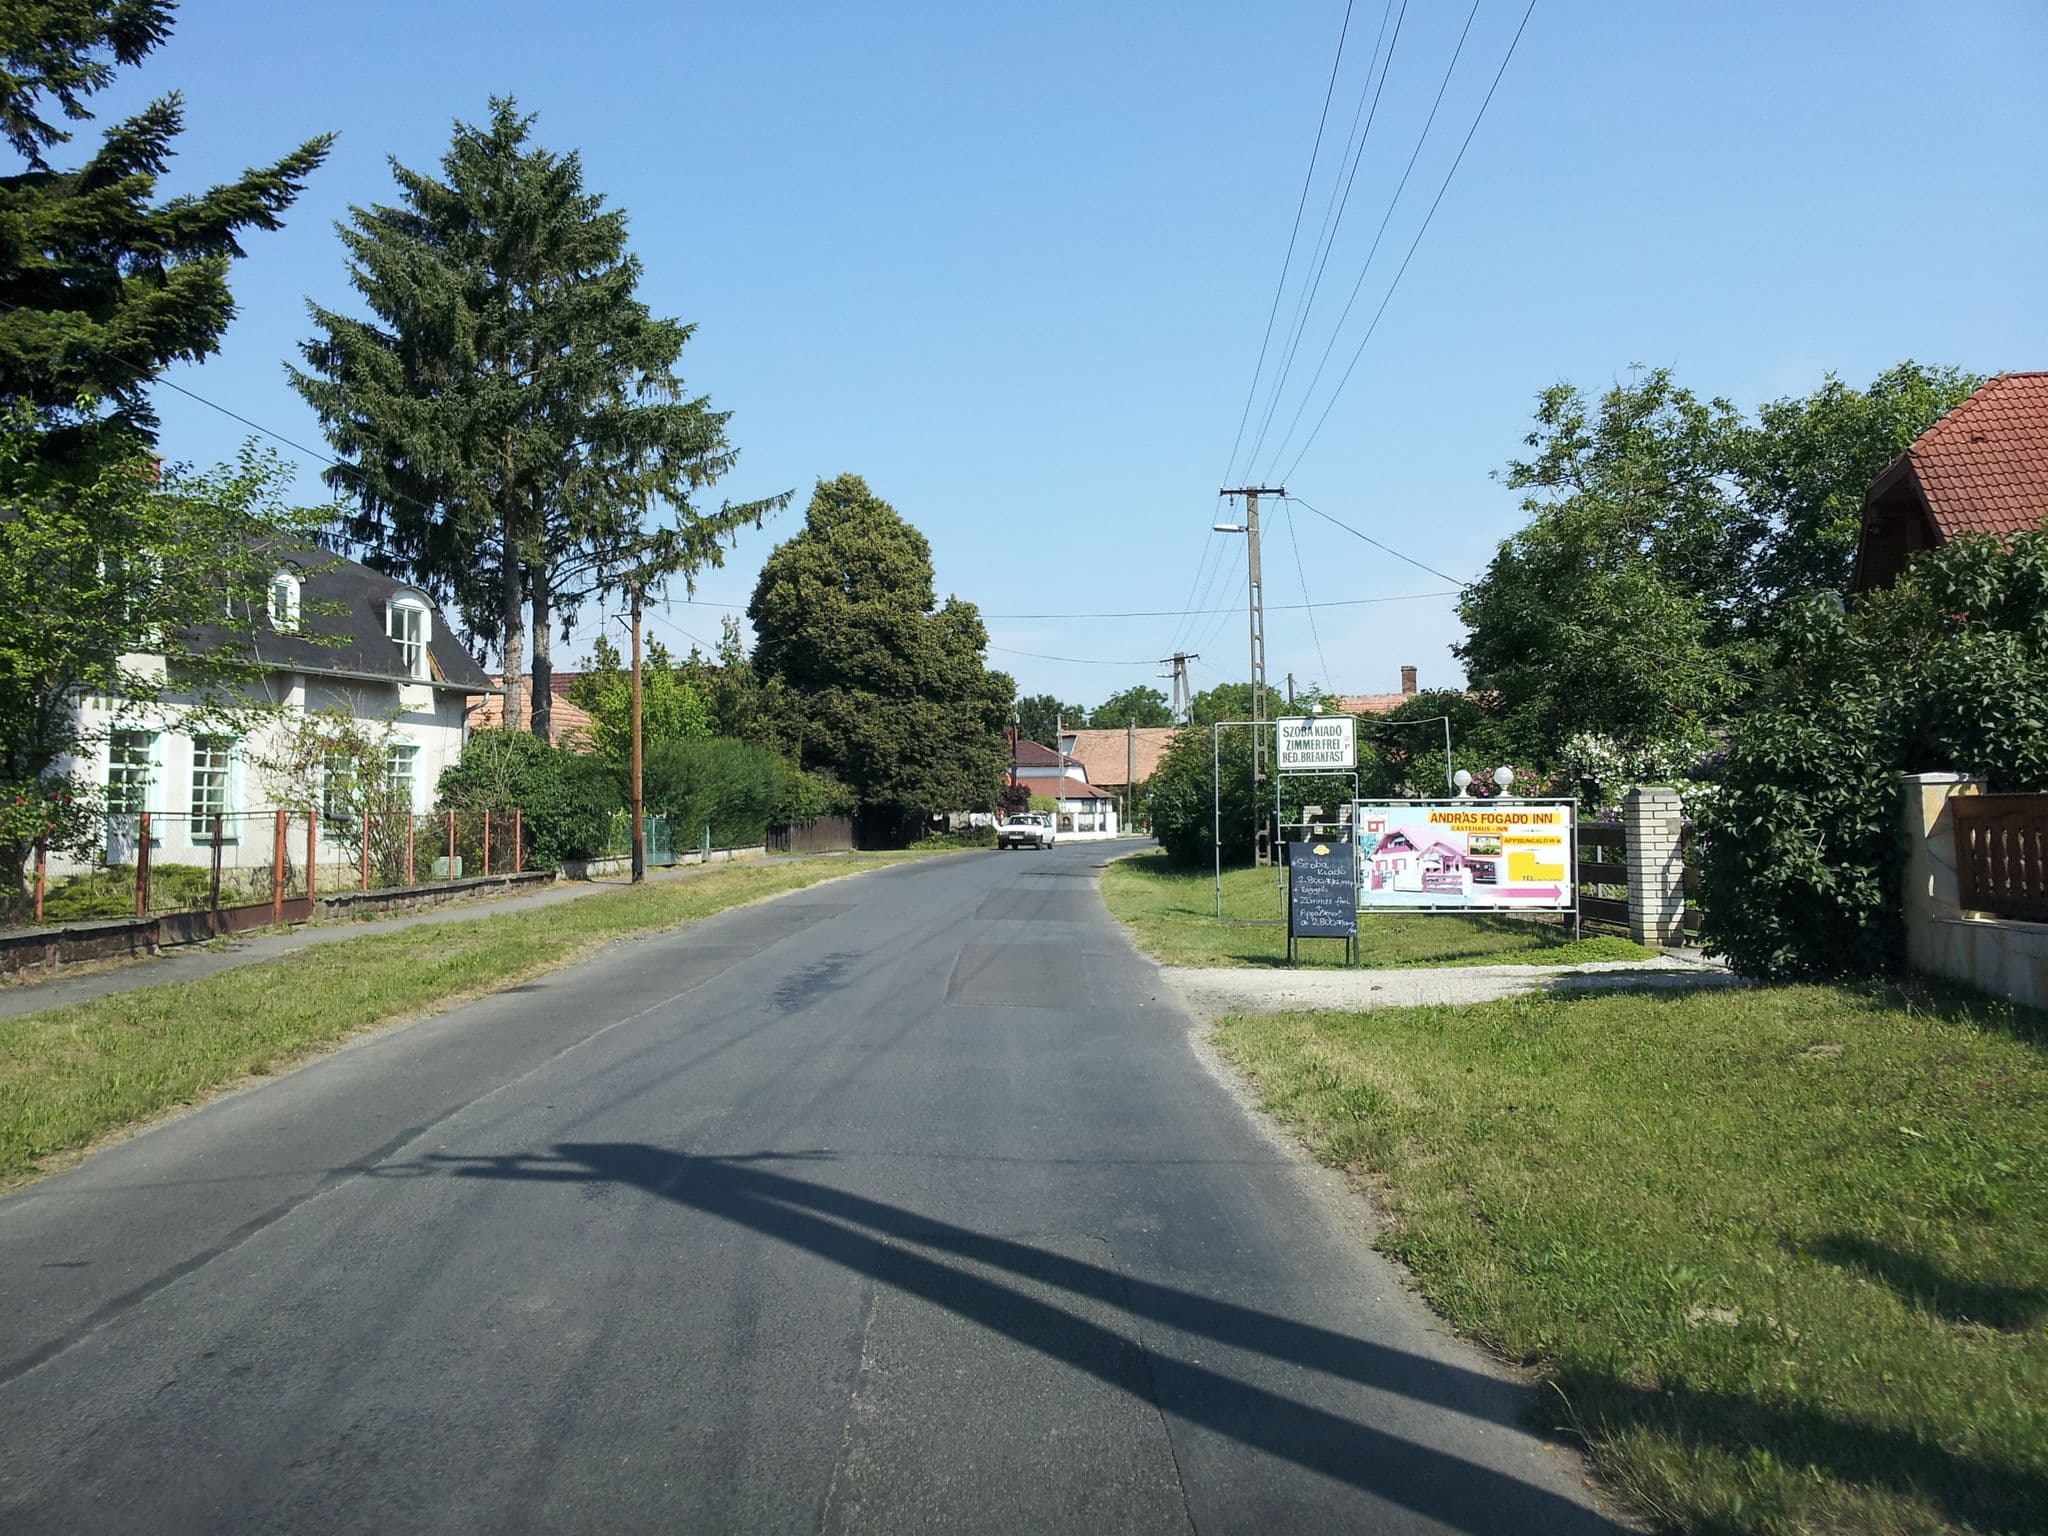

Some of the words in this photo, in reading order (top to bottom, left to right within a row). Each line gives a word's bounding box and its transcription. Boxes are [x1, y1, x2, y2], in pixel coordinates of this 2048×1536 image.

[1283, 726, 1314, 738] SZOBA
[1286, 739, 1321, 751] ZIMMER
[1322, 738, 1340, 750] FREI
[1533, 812, 1553, 825] INN
